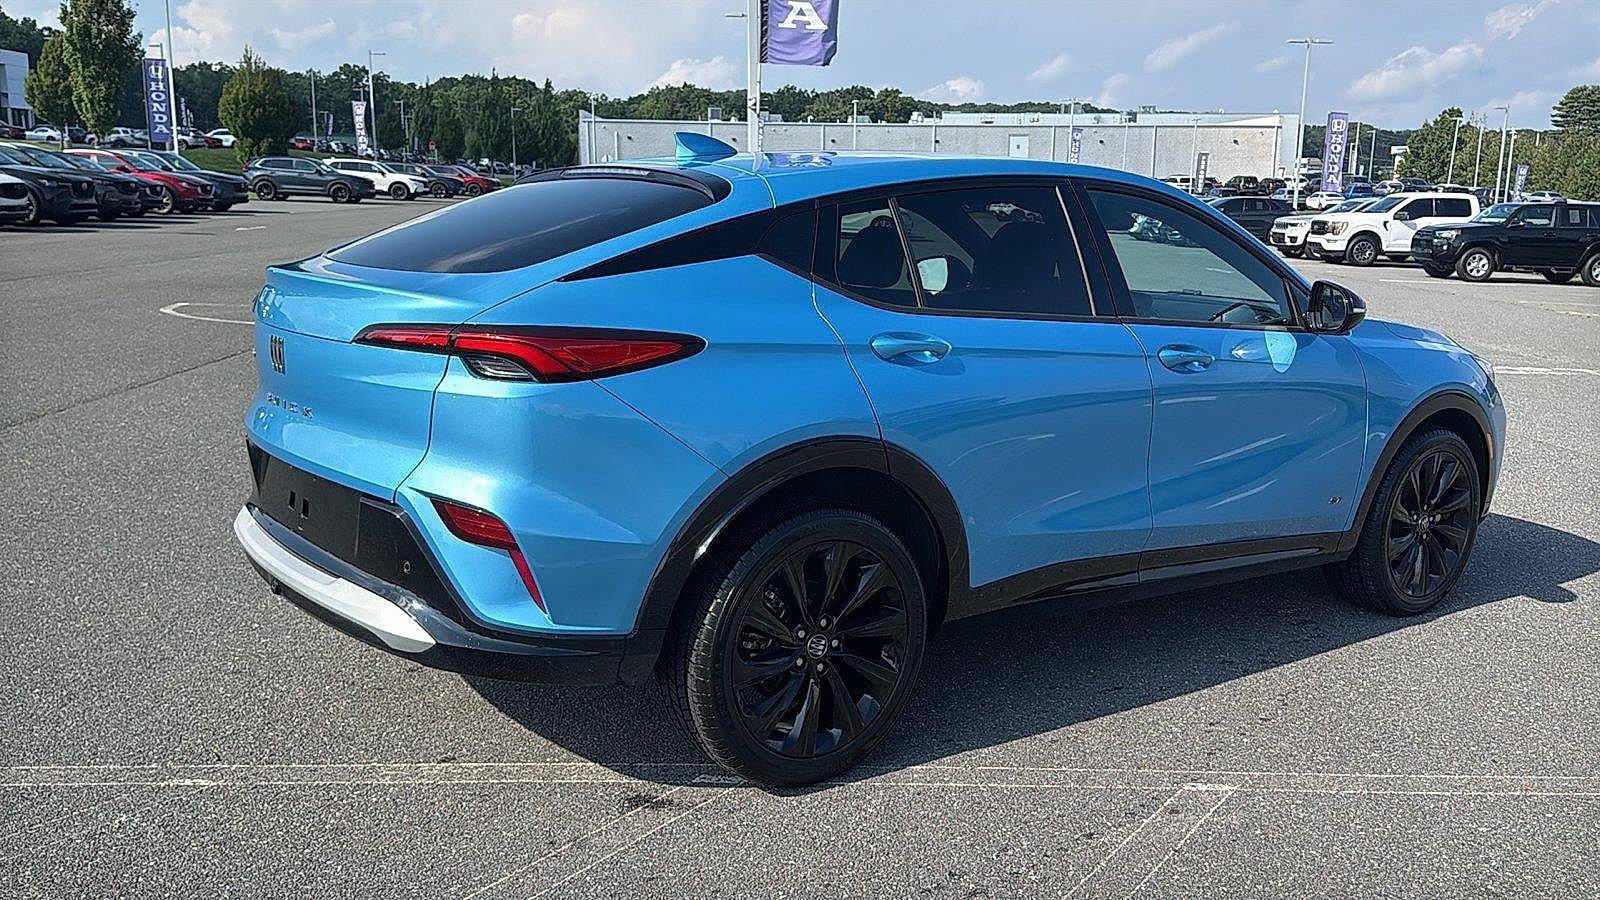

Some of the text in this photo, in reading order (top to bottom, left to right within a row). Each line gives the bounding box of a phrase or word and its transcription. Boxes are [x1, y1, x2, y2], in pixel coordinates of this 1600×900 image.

[777, 0, 829, 31] A
[149, 81, 170, 134] HONDA
[1326, 134, 1344, 184] HONDA
